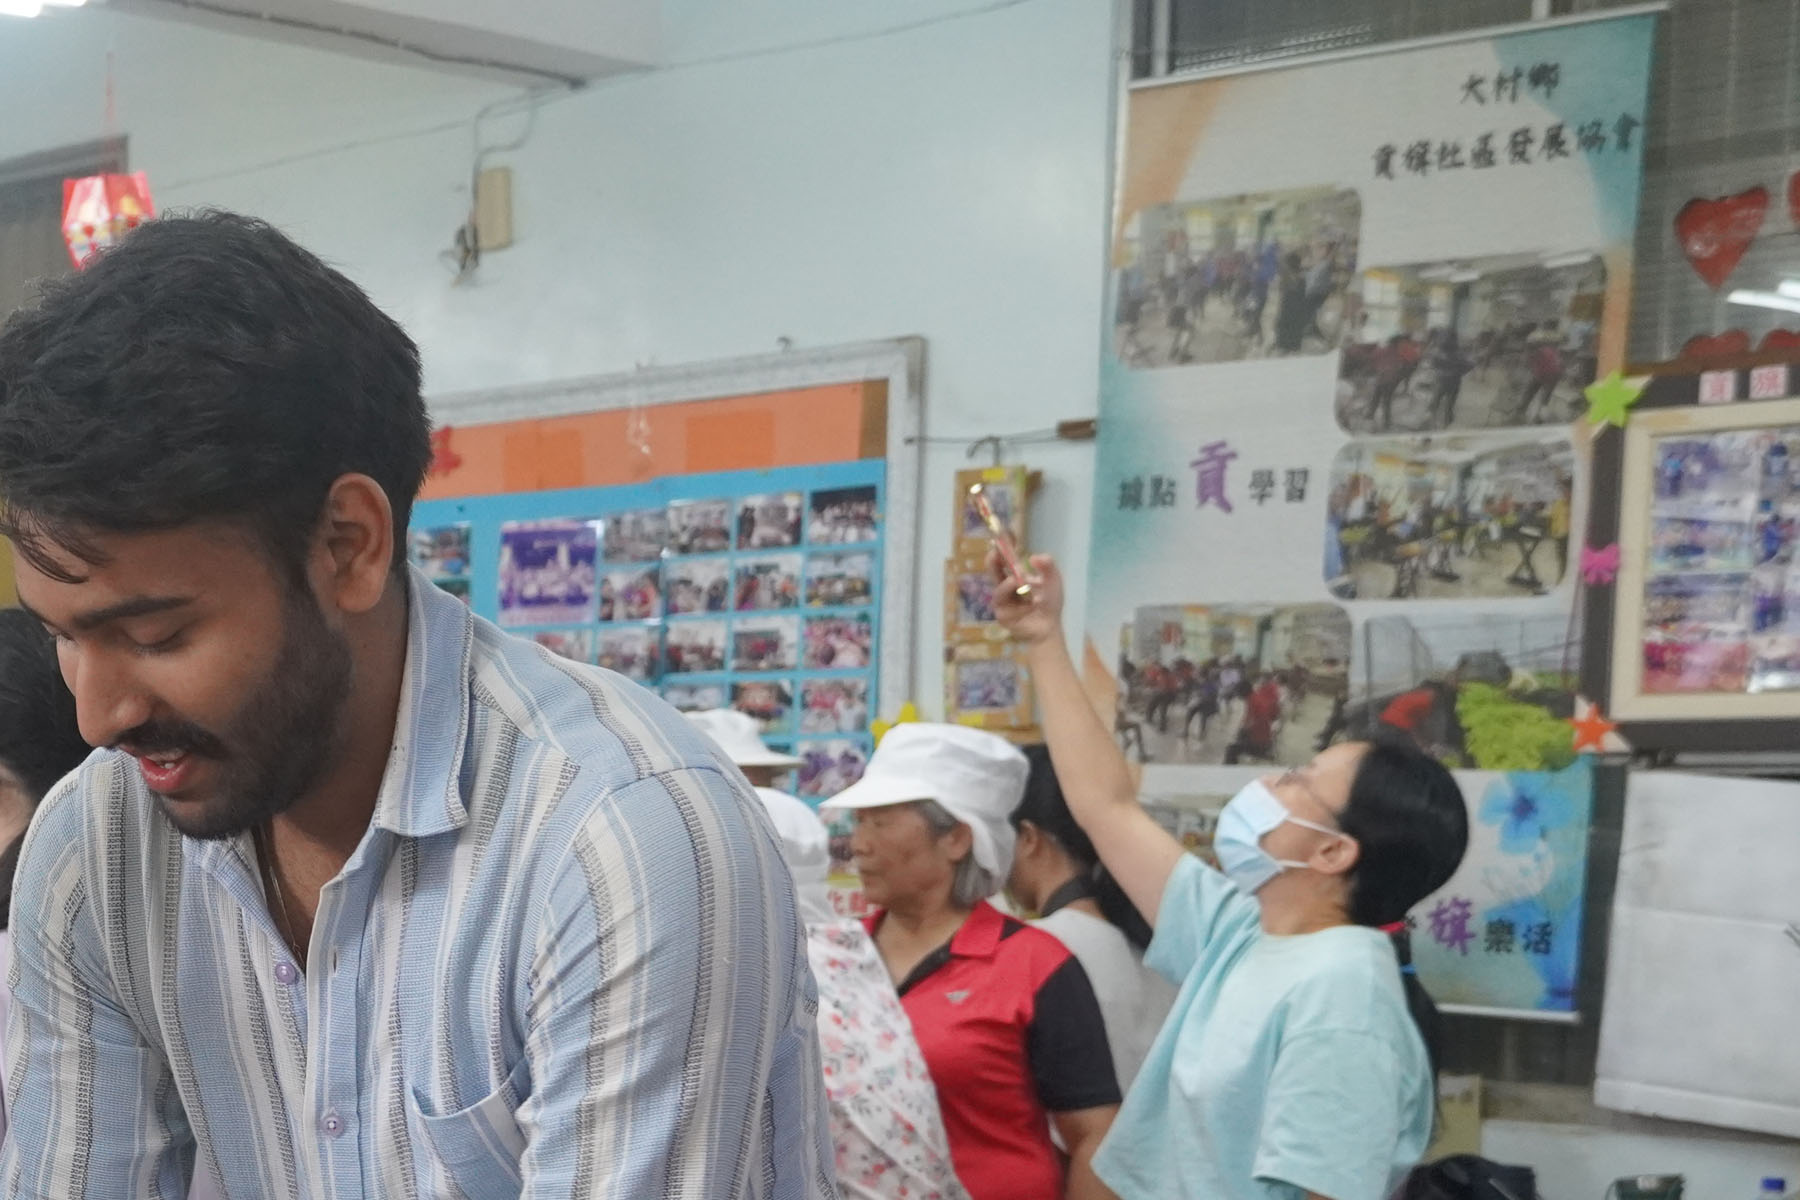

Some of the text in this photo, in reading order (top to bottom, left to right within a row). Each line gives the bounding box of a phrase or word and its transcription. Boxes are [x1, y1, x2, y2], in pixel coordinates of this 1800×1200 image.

[1460, 62, 1561, 105] 大村鄉
[1404, 896, 1553, 957] 旗樂活
